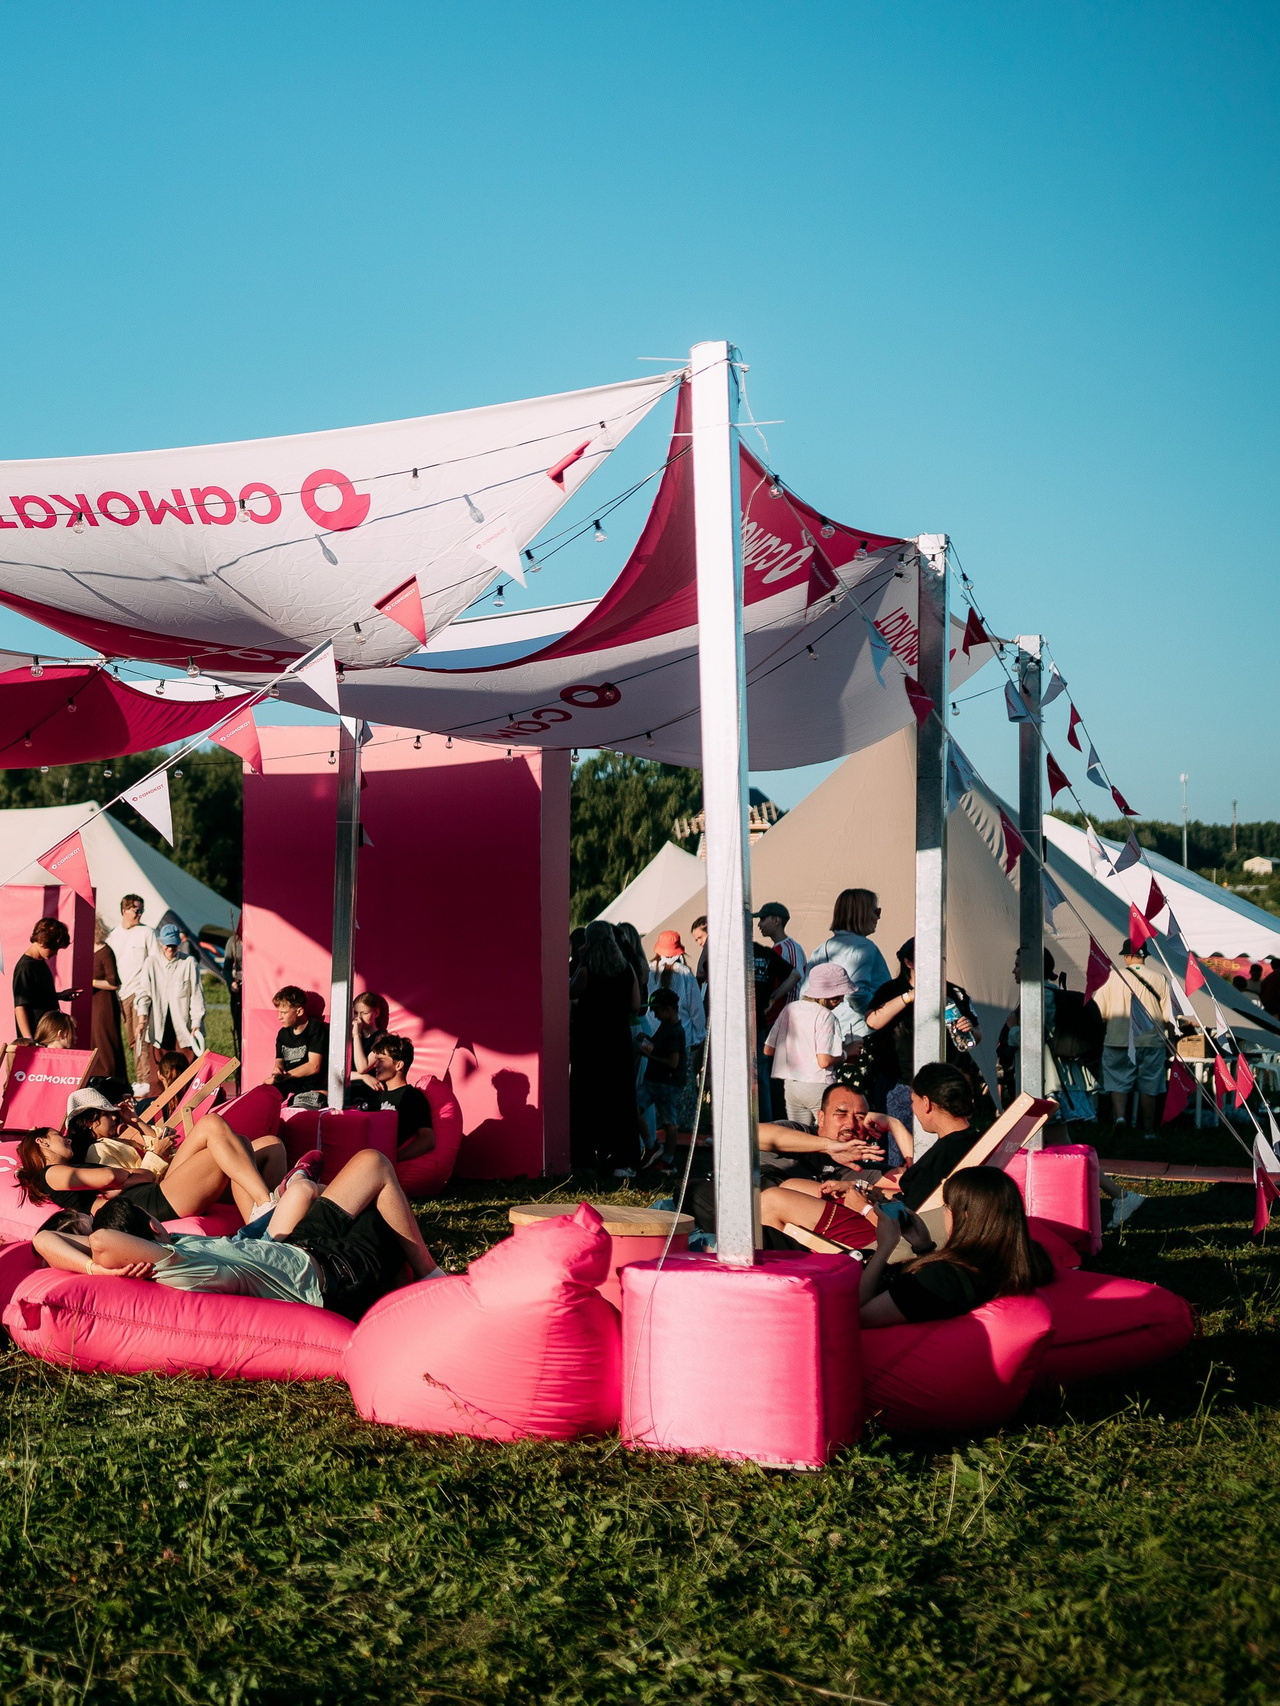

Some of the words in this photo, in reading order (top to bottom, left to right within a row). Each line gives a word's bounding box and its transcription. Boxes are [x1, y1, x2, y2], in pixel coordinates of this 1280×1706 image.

[391, 588, 416, 607] самокат
[305, 652, 330, 669] самокат
[226, 720, 251, 738] самокат
[138, 783, 164, 799] самокат
[57, 847, 81, 866] самокат
[27, 1073, 82, 1086] самокат
